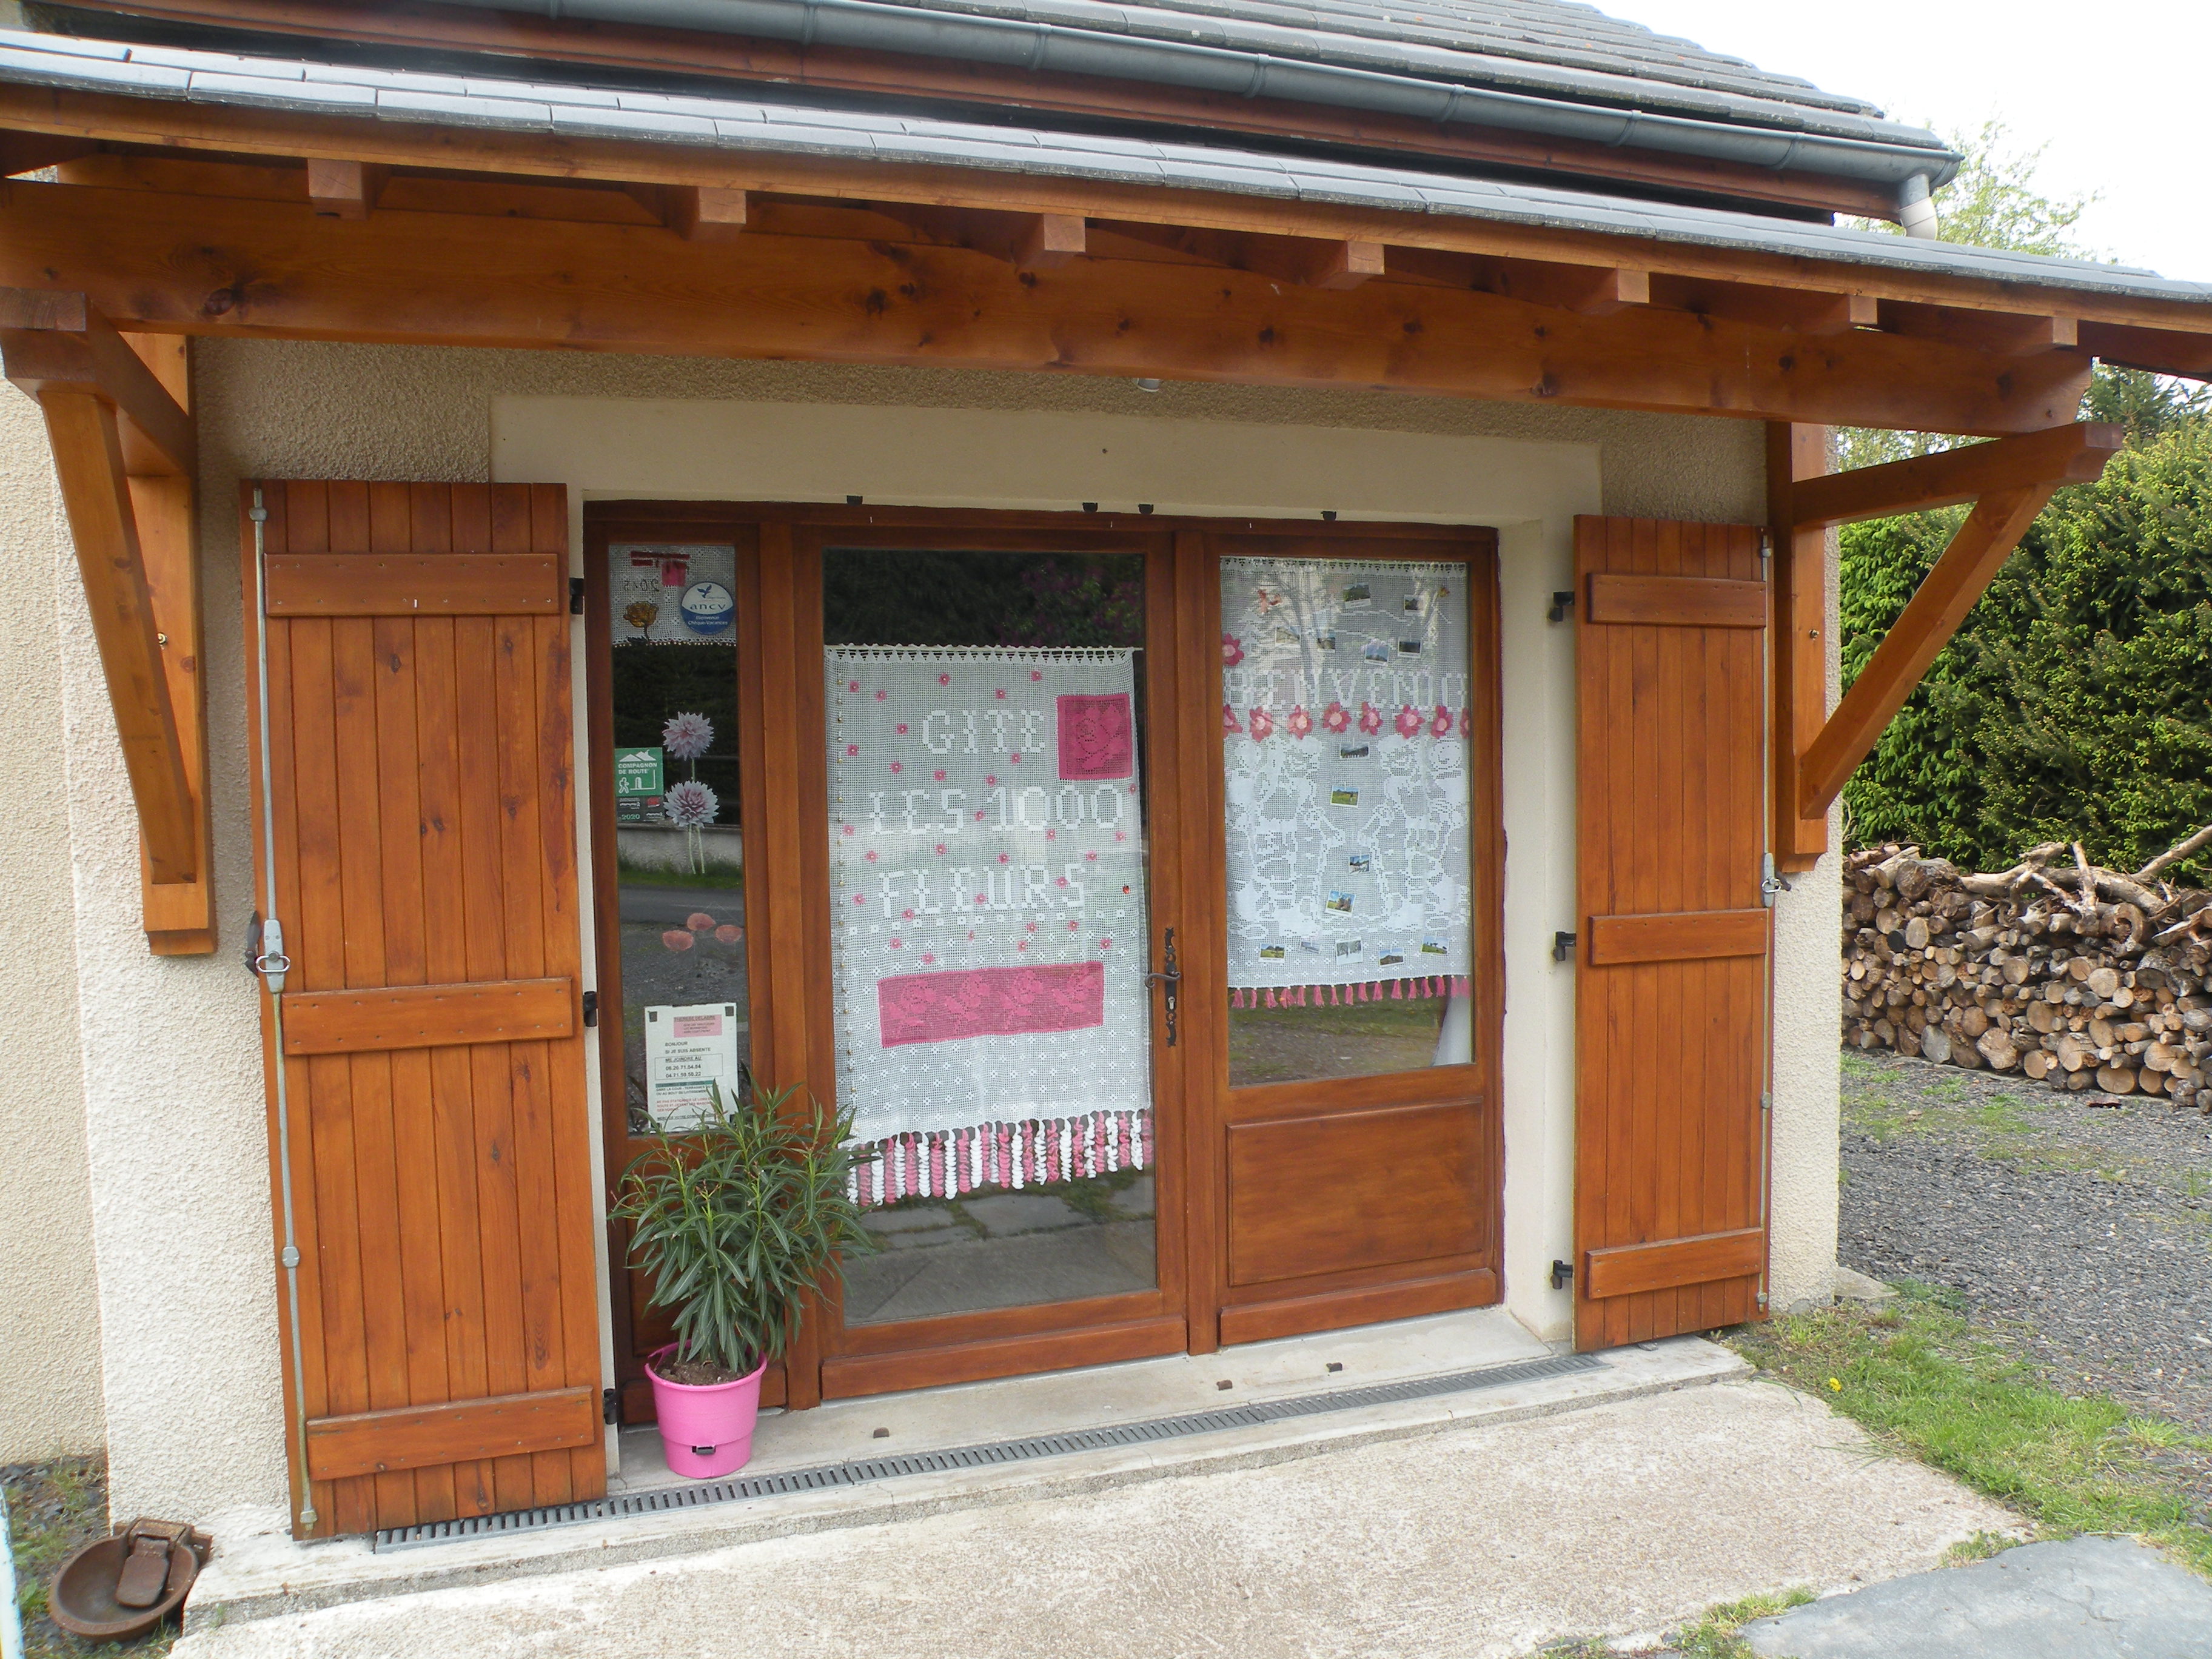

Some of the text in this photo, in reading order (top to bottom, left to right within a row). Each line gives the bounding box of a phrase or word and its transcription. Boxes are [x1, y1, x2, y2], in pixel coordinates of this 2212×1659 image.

[922, 709, 1045, 754] GITE
[870, 783, 1123, 835] LES 1000
[879, 863, 1085, 919] FLEURS
